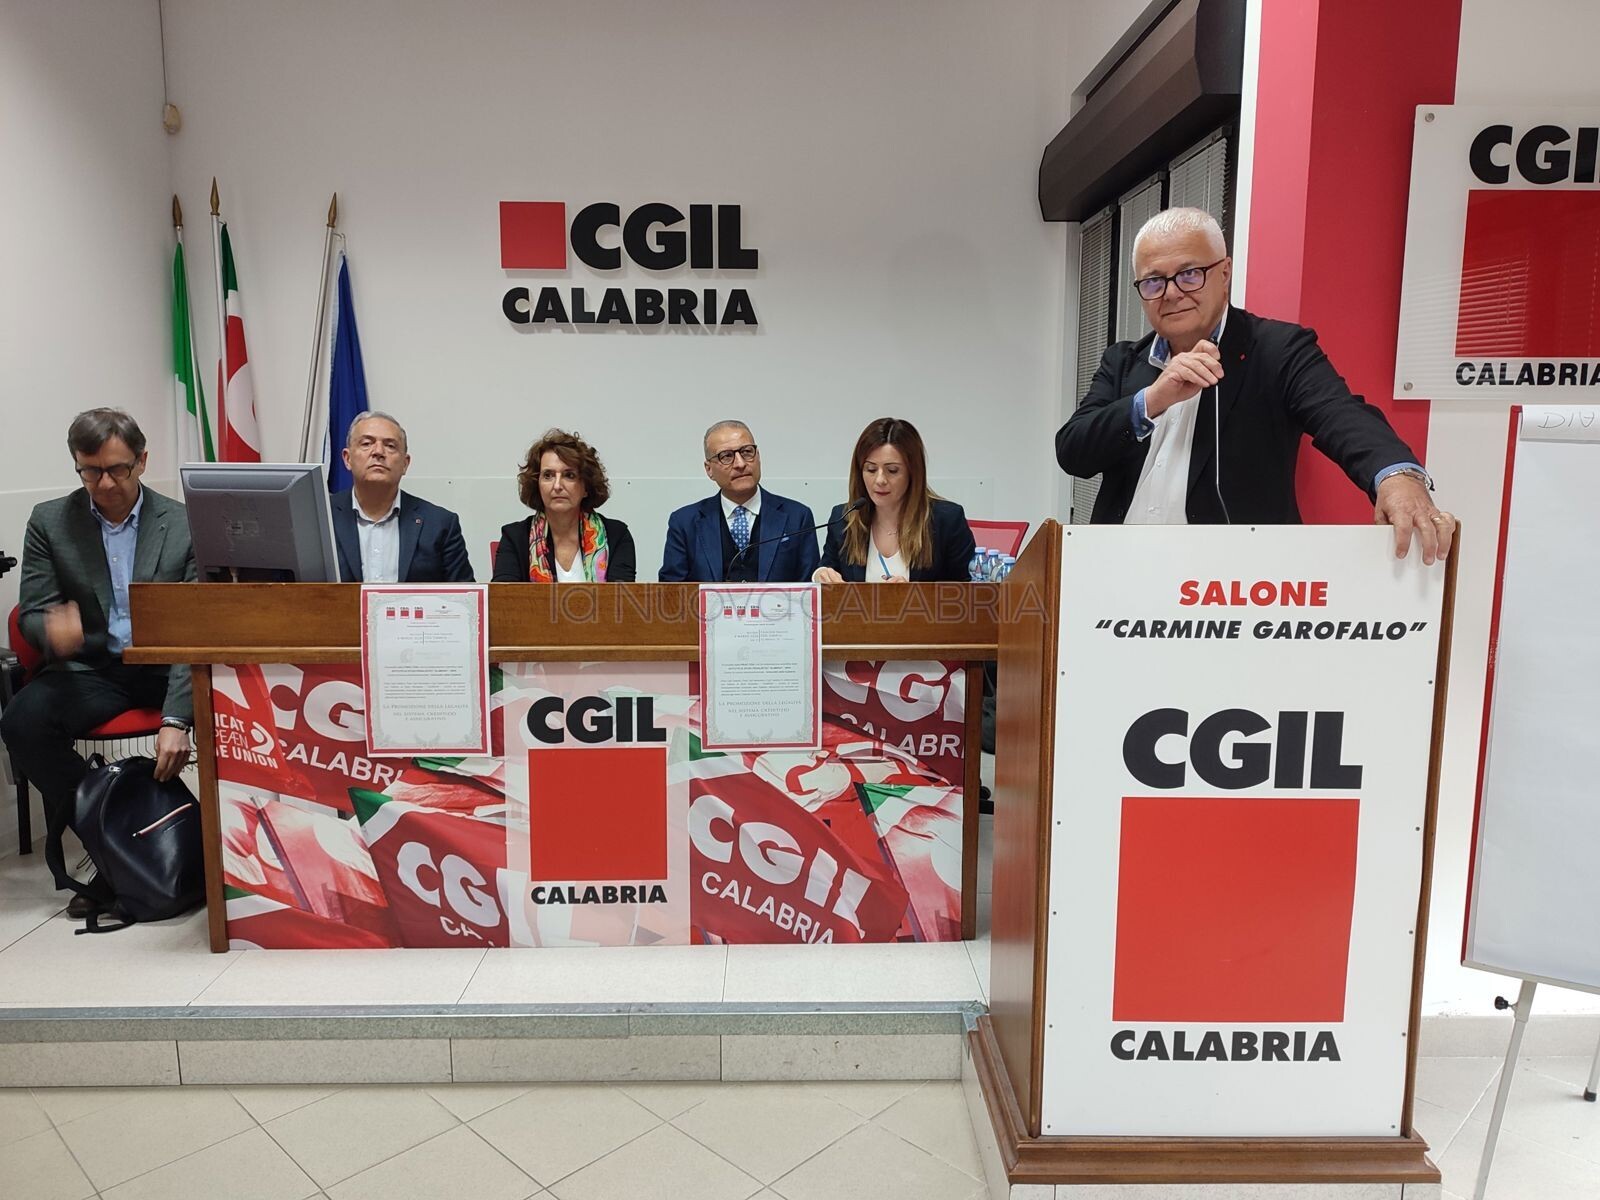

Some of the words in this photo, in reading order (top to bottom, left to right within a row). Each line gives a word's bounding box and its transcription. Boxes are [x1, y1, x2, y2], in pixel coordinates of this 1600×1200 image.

[1469, 124, 1600, 185] CGI
[570, 202, 758, 270] CGIL
[502, 287, 758, 325] CALABRIA
[1179, 580, 1328, 607] SALONE
[527, 695, 667, 744] CGIL
[231, 746, 278, 769] UNION
[1122, 708, 1363, 790] CGIL
[687, 795, 872, 939] CGIL
[531, 885, 667, 905] CALABRIA
[1110, 1030, 1341, 1061] CALABRIA
